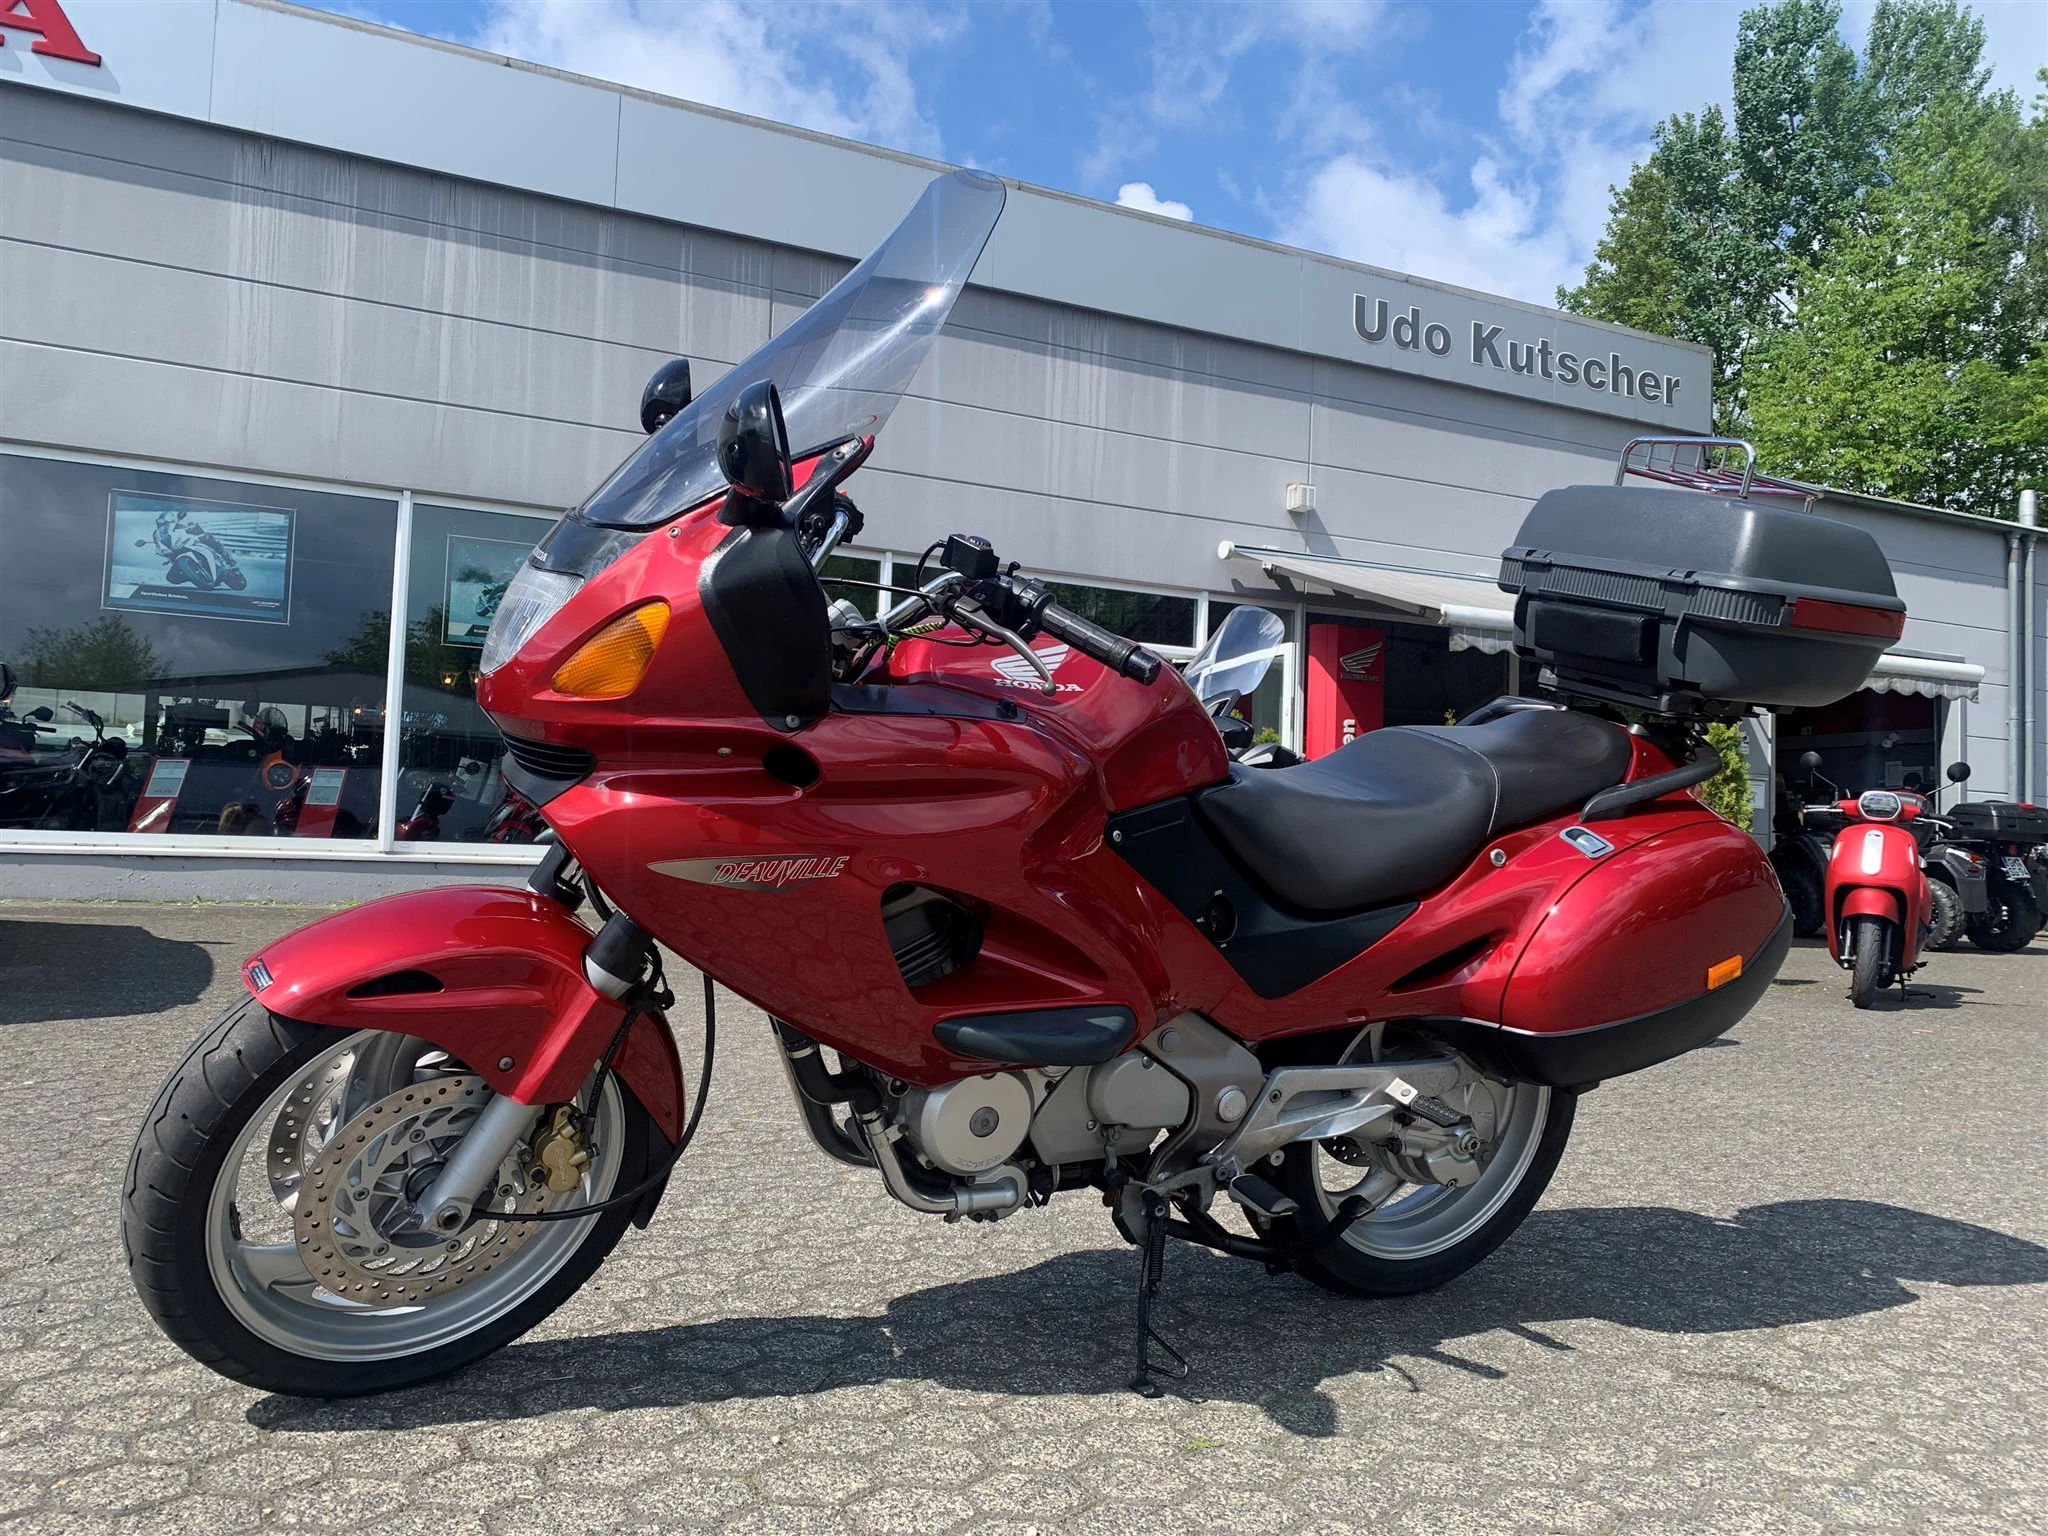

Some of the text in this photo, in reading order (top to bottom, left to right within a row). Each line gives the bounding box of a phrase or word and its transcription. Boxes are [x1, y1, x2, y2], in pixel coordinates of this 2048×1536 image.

[1353, 293, 1681, 406] Udo Kutscher
[711, 856, 849, 888] DEAUVILLE
